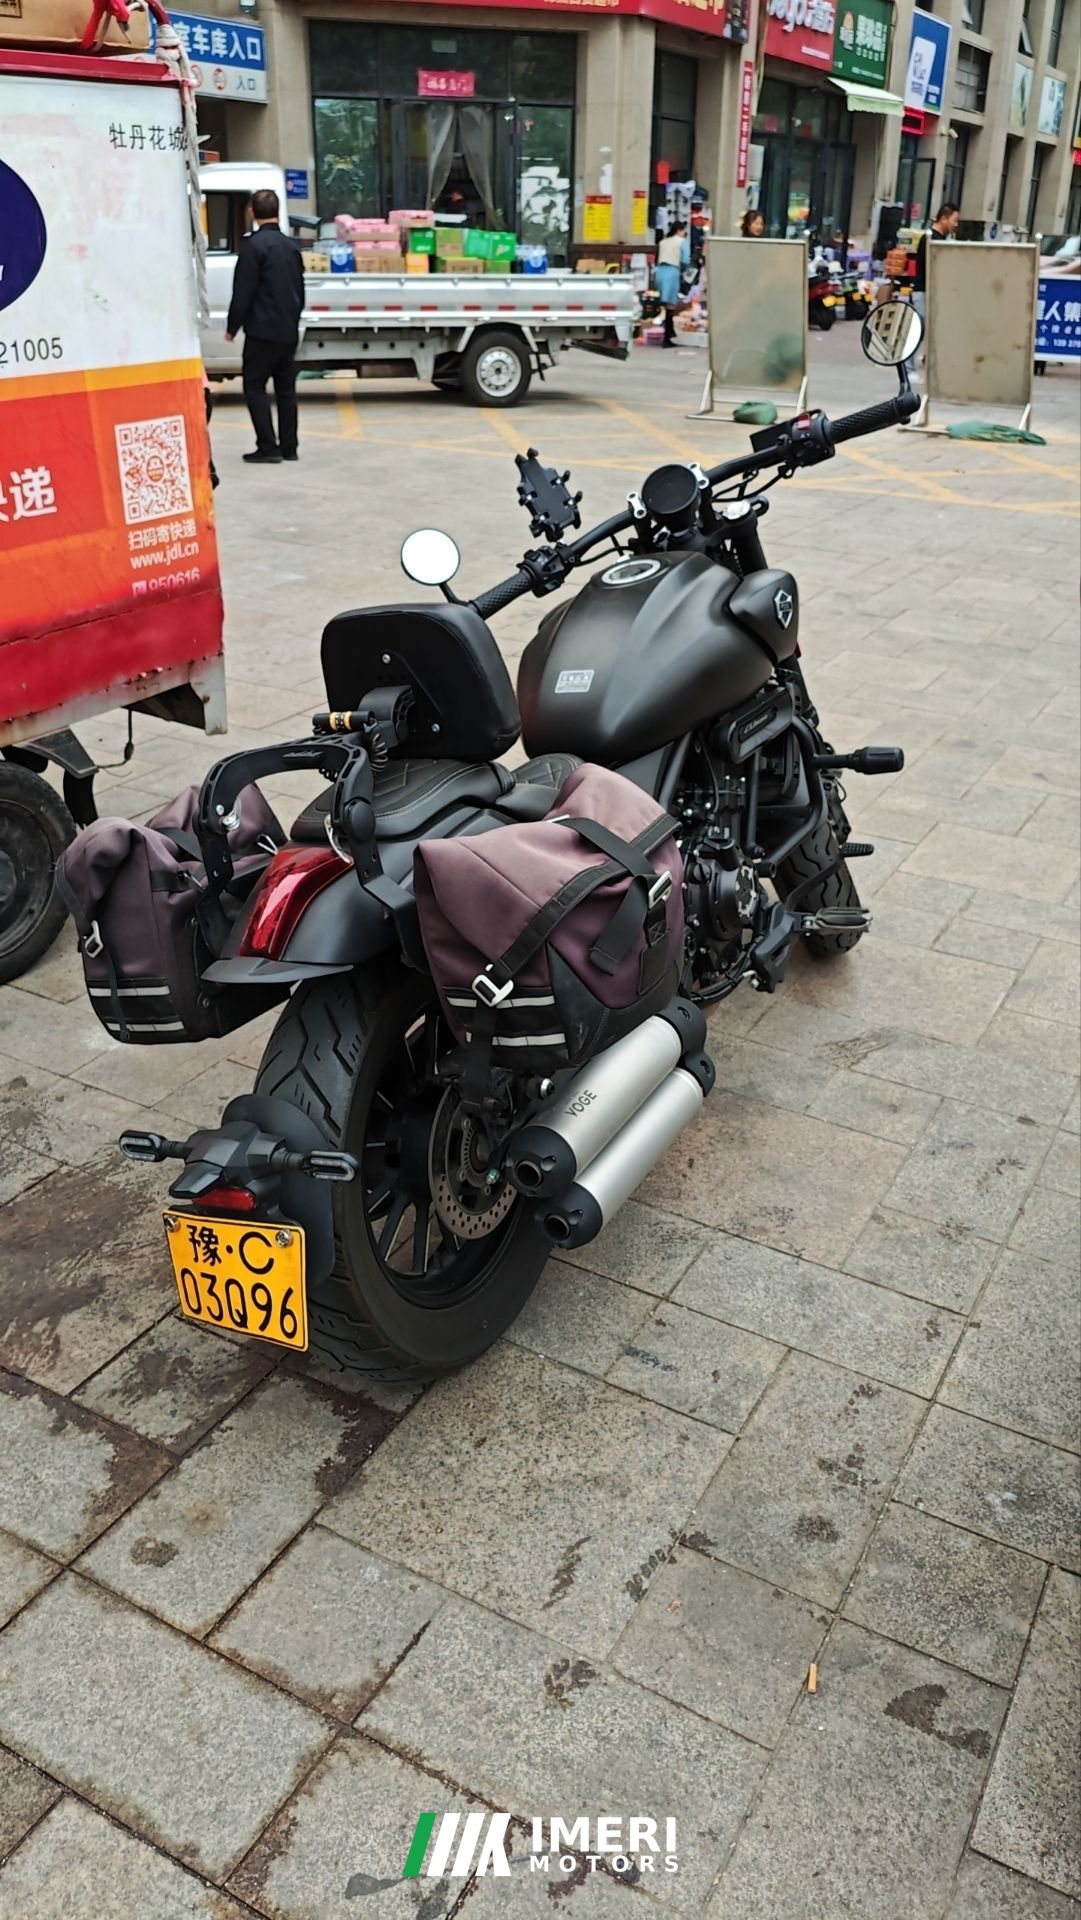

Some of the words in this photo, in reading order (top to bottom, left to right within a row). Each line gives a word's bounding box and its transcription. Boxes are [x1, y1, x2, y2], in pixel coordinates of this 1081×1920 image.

[236, 76, 256, 91] 入口
[0, 465, 57, 522] 递
[128, 518, 197, 551] 扫码寄快递
[130, 541, 199, 569] www.jdl.cn
[564, 1089, 598, 1117] VOGE
[186, 1224, 275, 1275] 豫·C
[180, 1267, 298, 1339] 03Q96
